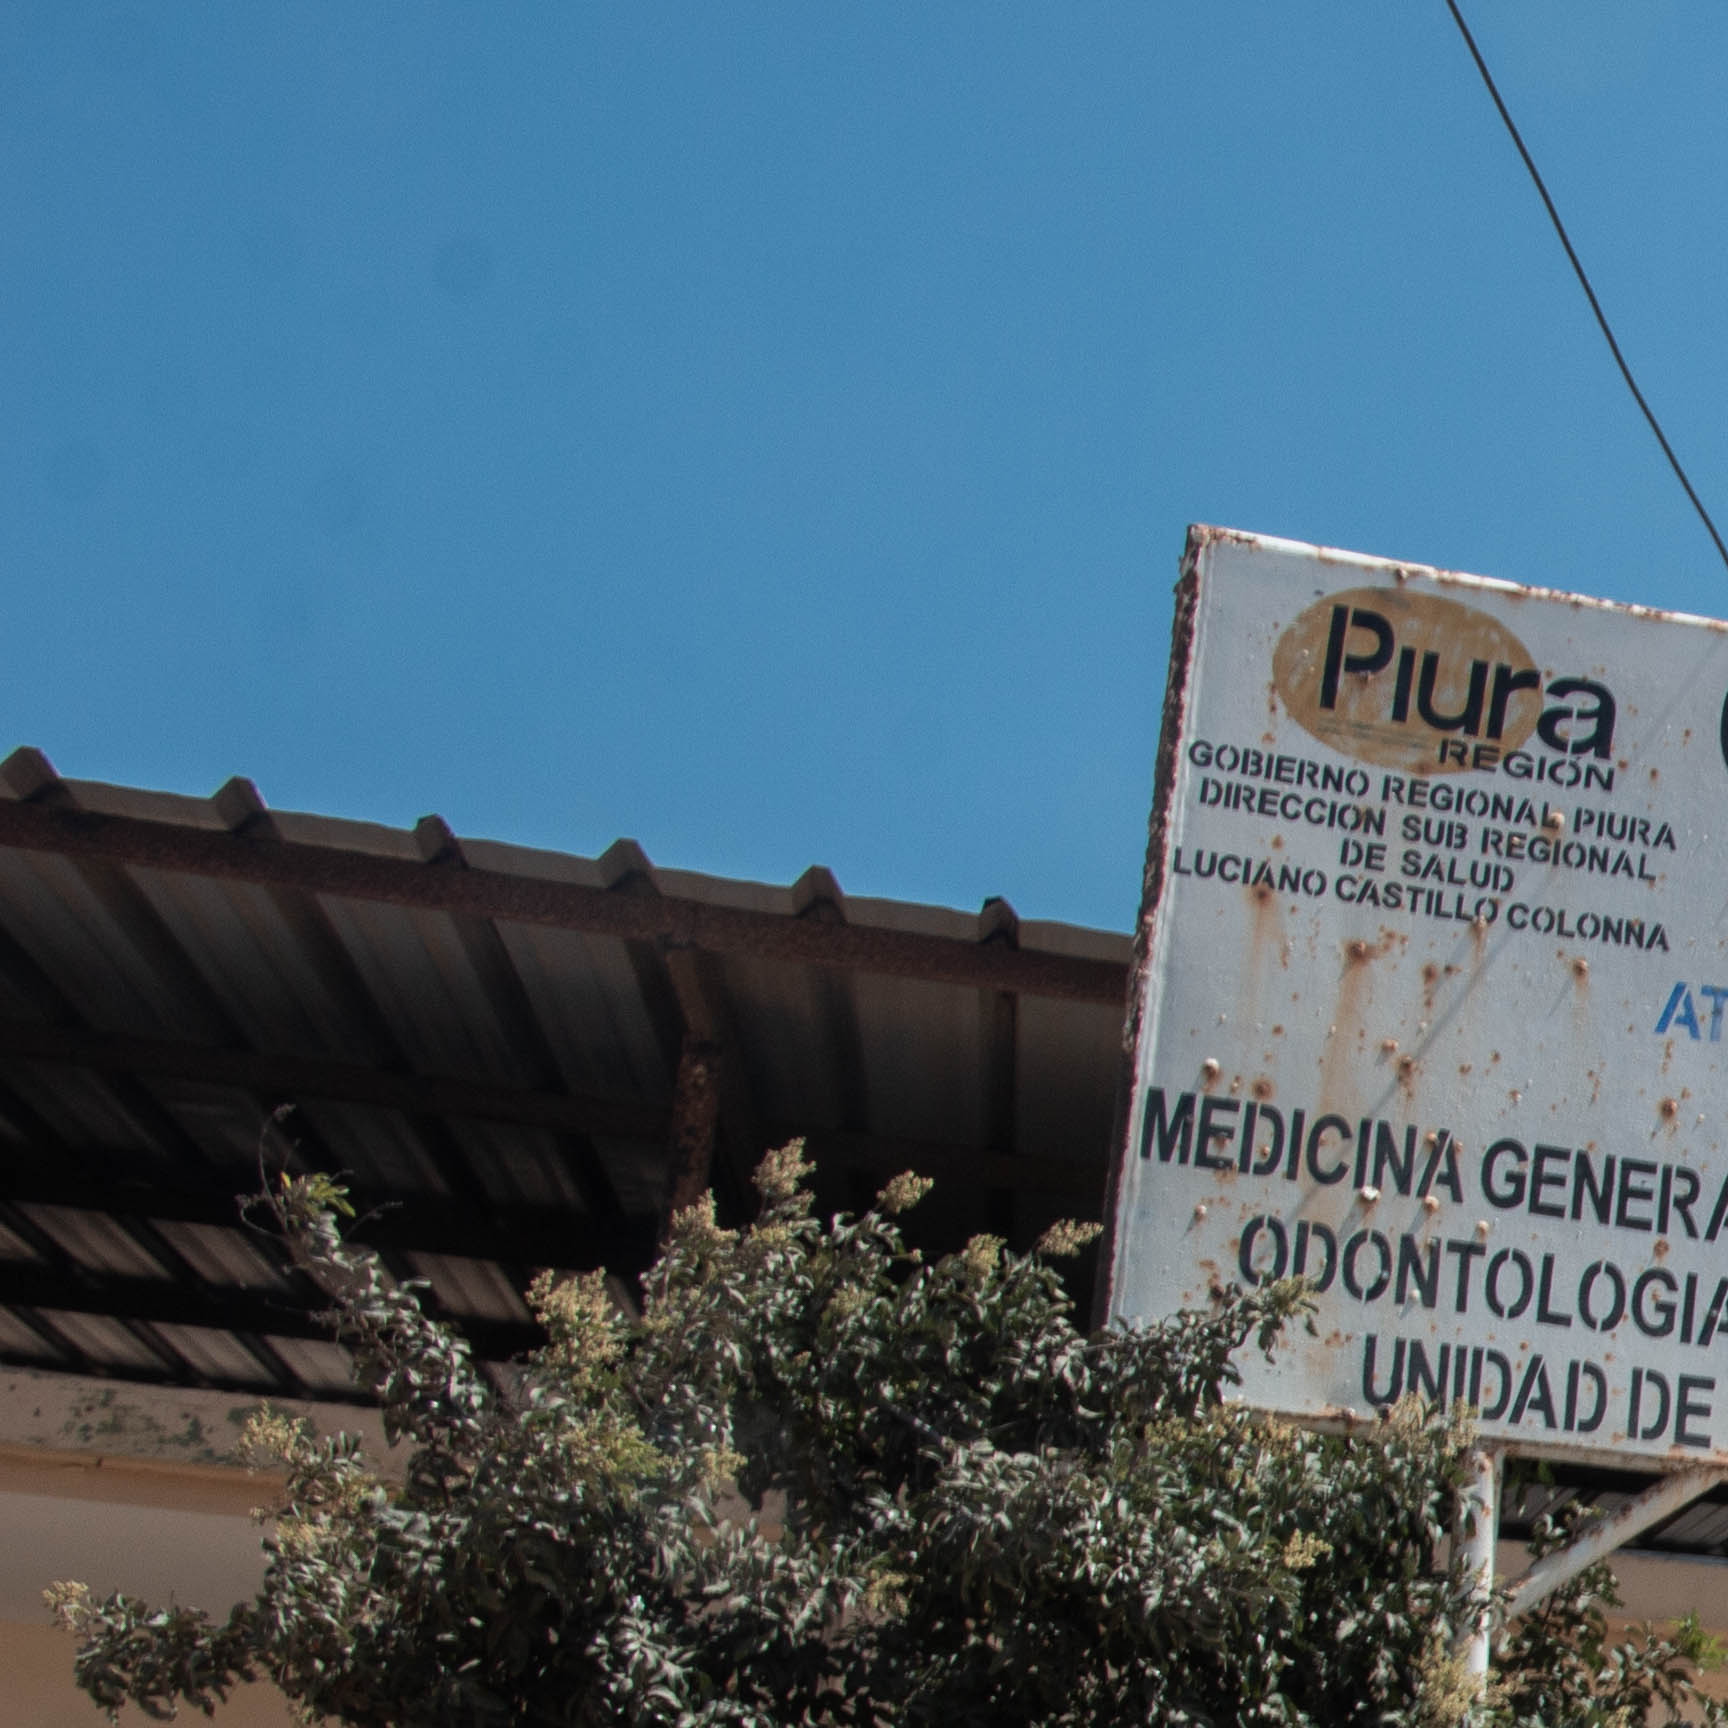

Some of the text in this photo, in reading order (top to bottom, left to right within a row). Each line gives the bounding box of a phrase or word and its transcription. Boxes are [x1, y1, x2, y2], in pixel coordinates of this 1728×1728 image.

[1319, 604, 1617, 760] Piura
[1188, 739, 1677, 851] GOBIERNO REGIONAL PIURA
[1199, 779, 1657, 882] DIRECCION SUB REGIONAL
[1173, 847, 1671, 953] LUCIANO CASTILLO COLONNA
[1340, 839, 1515, 893] DE SALUD
[1140, 1087, 1464, 1203] MEDICINA
[1362, 1333, 1607, 1432] UNIDAD
[1628, 1367, 1716, 1447] DE
